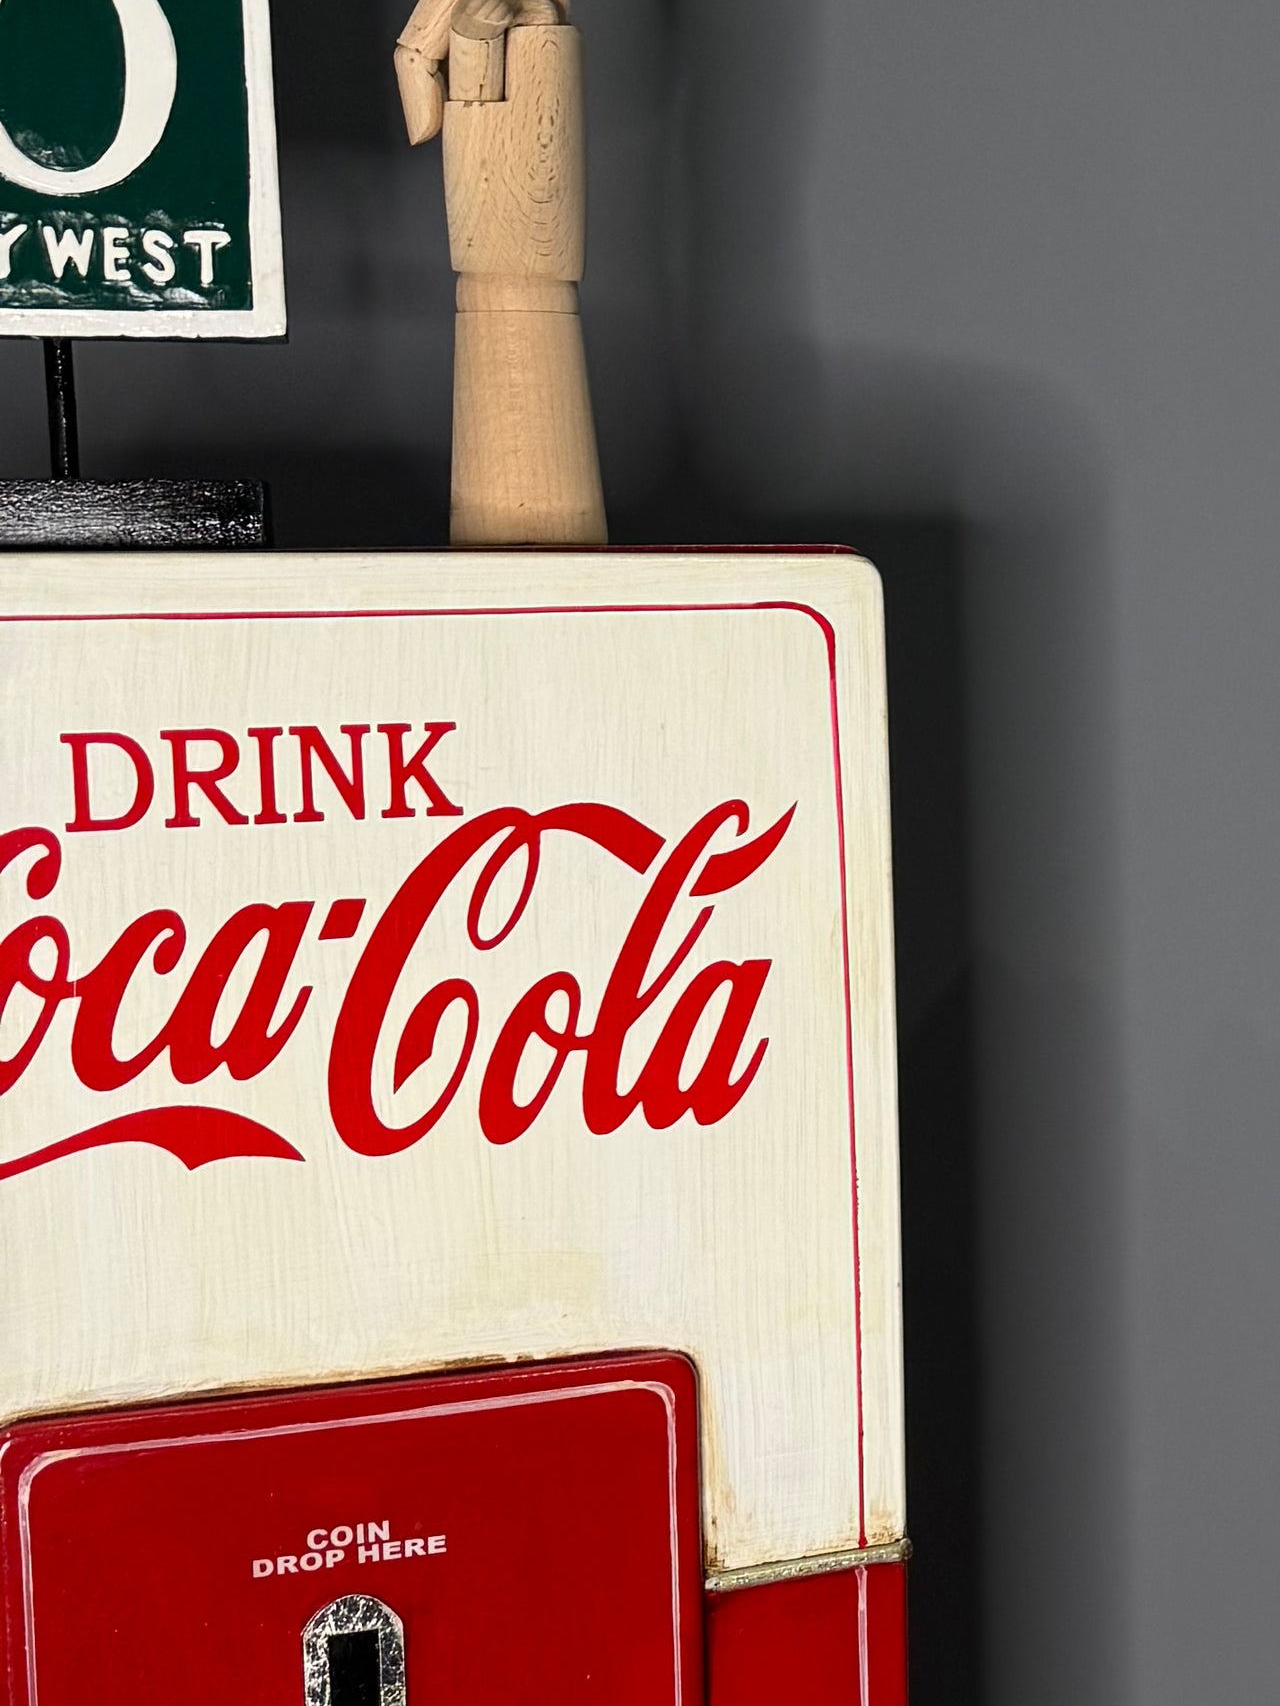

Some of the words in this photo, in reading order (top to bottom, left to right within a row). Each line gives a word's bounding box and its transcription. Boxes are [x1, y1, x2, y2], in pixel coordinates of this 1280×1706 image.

[43, 225, 231, 285] WEST
[60, 722, 464, 833] DRINK
[252, 1548, 346, 1579] DROP
[357, 1534, 448, 1565] HERE
[306, 1519, 391, 1551] COIN
